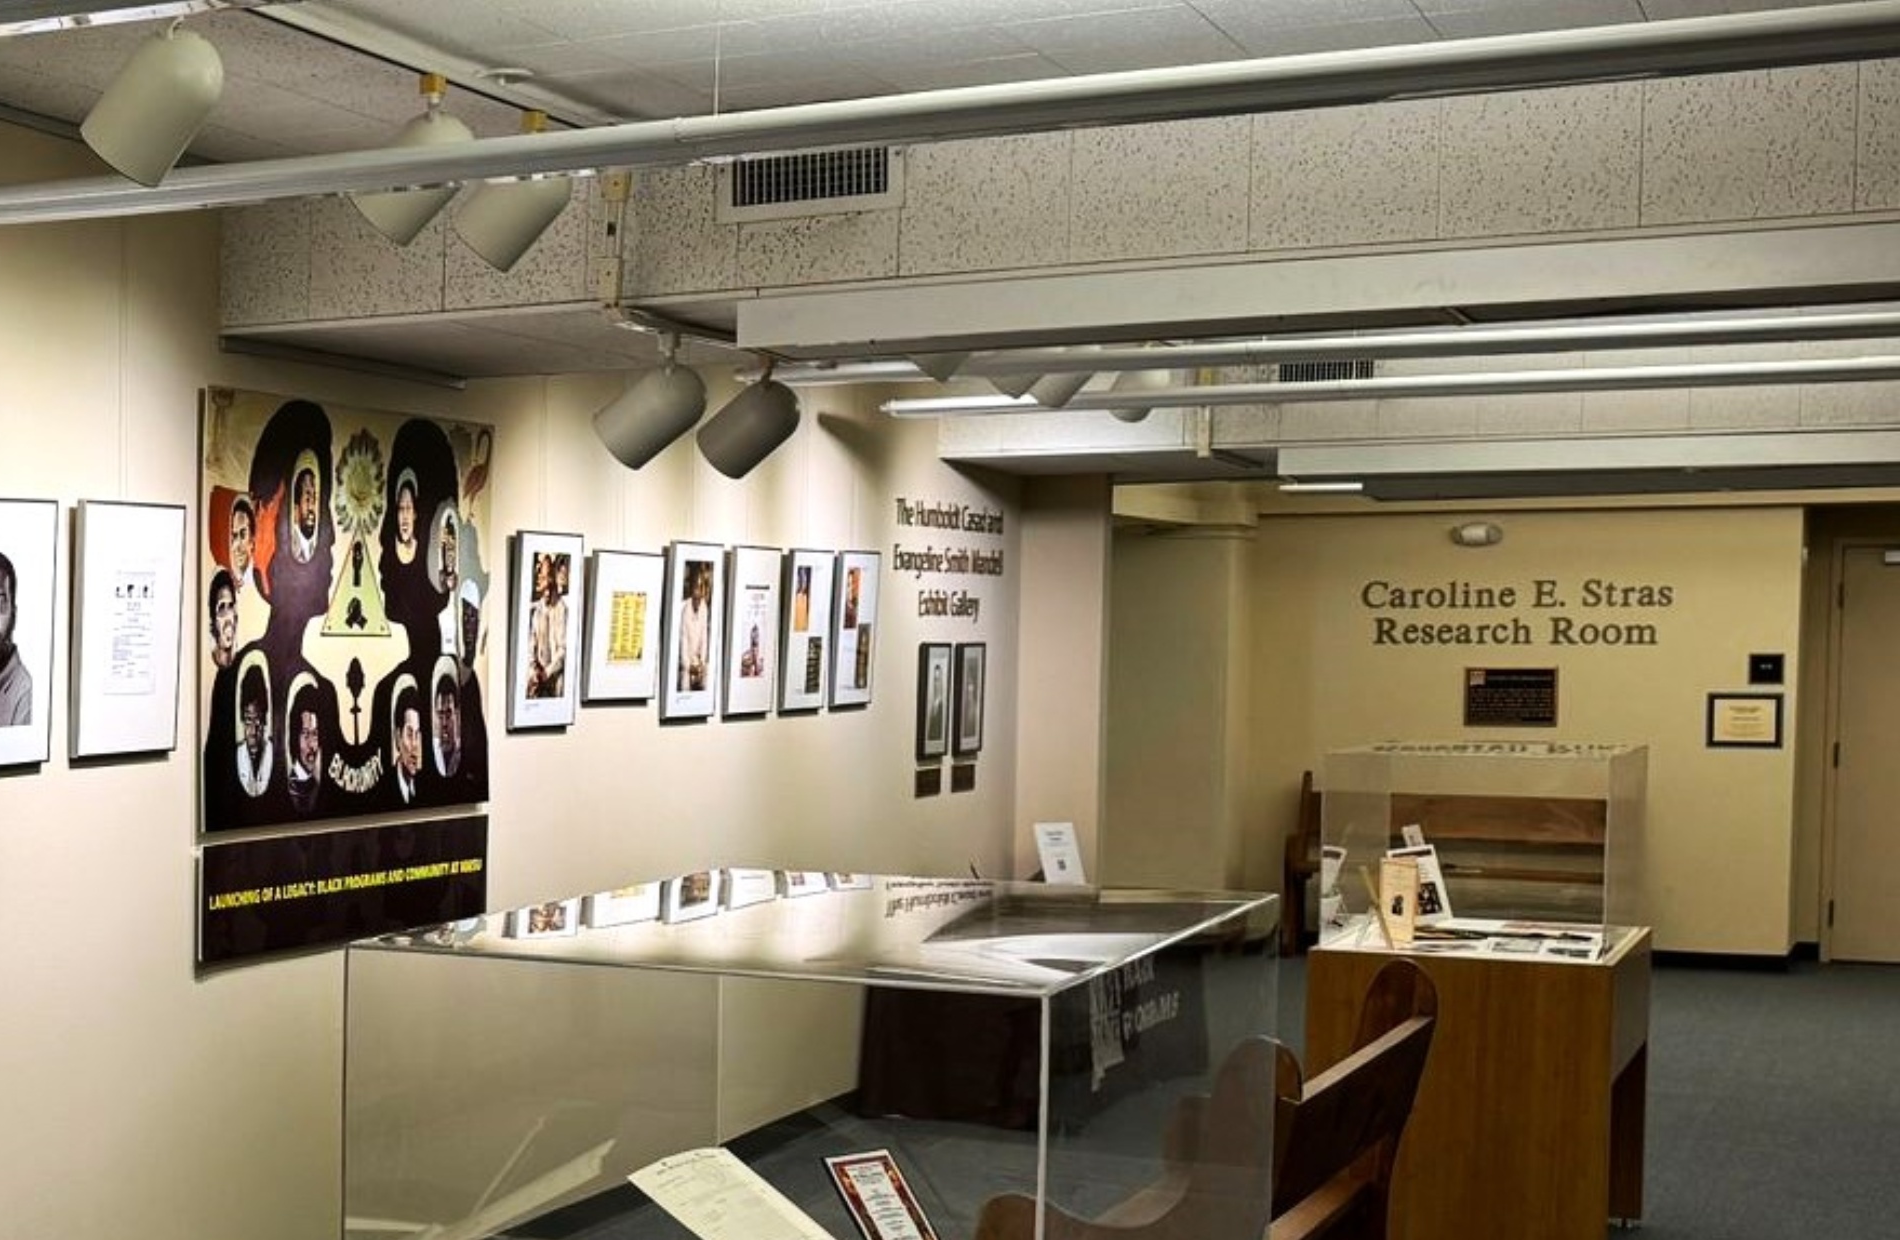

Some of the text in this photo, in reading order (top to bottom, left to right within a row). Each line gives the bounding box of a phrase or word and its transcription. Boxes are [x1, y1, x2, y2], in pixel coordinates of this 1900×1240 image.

[1361, 578, 1674, 609] Caroline E. Stras
[1374, 616, 1658, 645] Research Room
[209, 889, 260, 911] LAUNCHING
[261, 887, 273, 902] OF
[274, 886, 281, 901] A
[317, 876, 344, 894] BLACK
[345, 871, 387, 889] PROGRAMS
[388, 869, 404, 884] AND
[406, 863, 450, 881] COMMUNITY
[451, 861, 459, 874] AT
